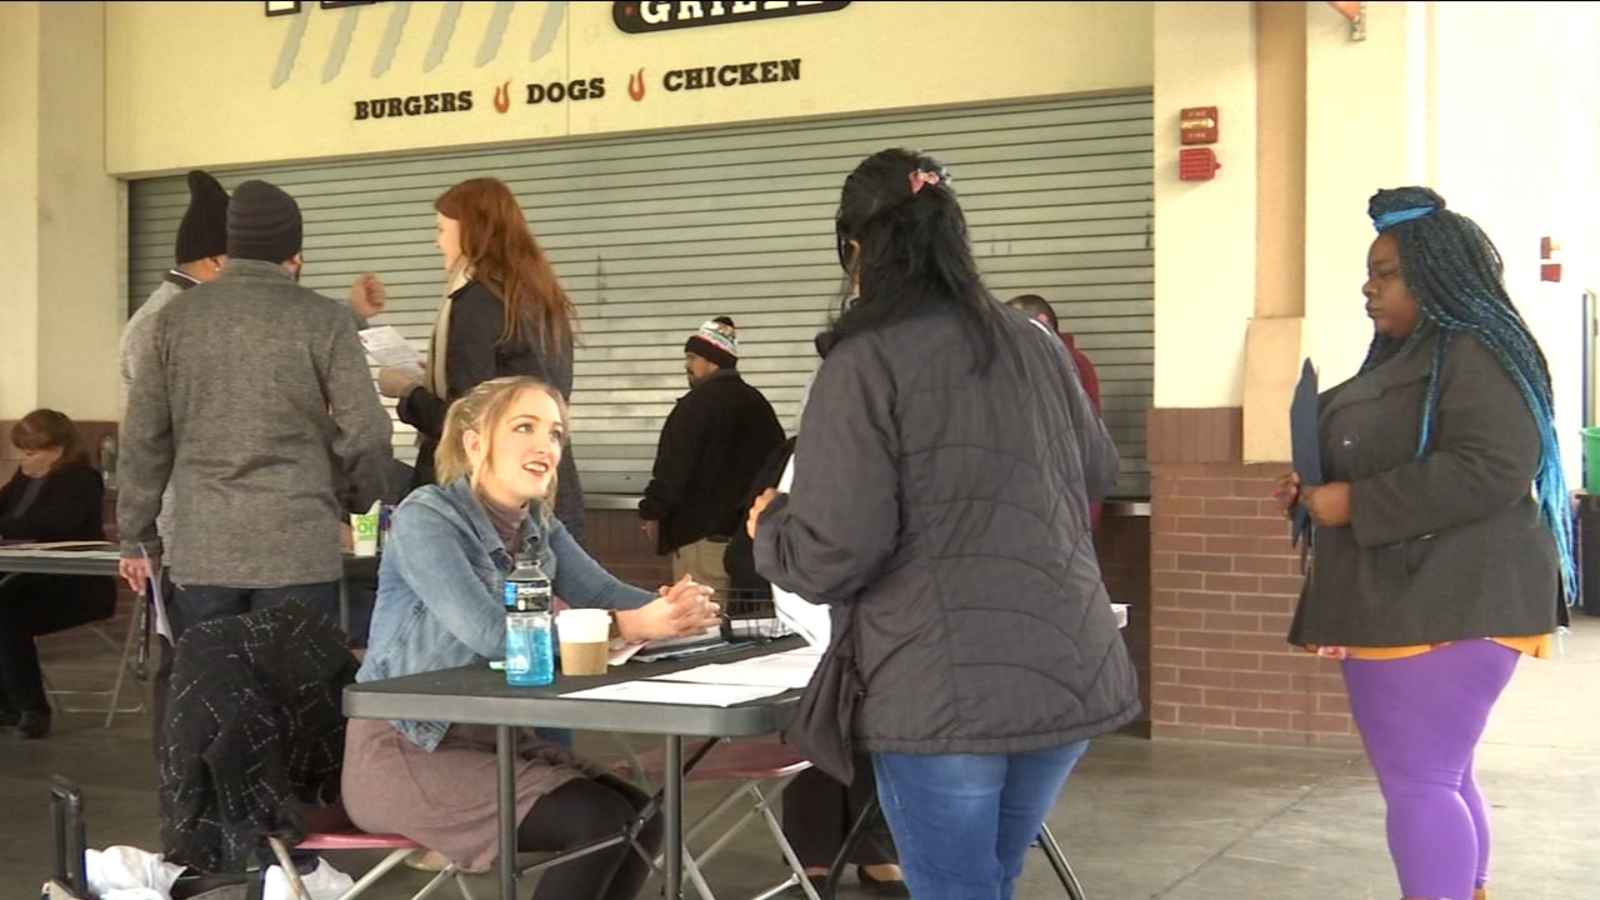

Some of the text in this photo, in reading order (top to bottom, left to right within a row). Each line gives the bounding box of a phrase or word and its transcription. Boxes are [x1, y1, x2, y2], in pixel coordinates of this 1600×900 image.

[354, 58, 801, 120] BURGERS DOGS CHICKEN
